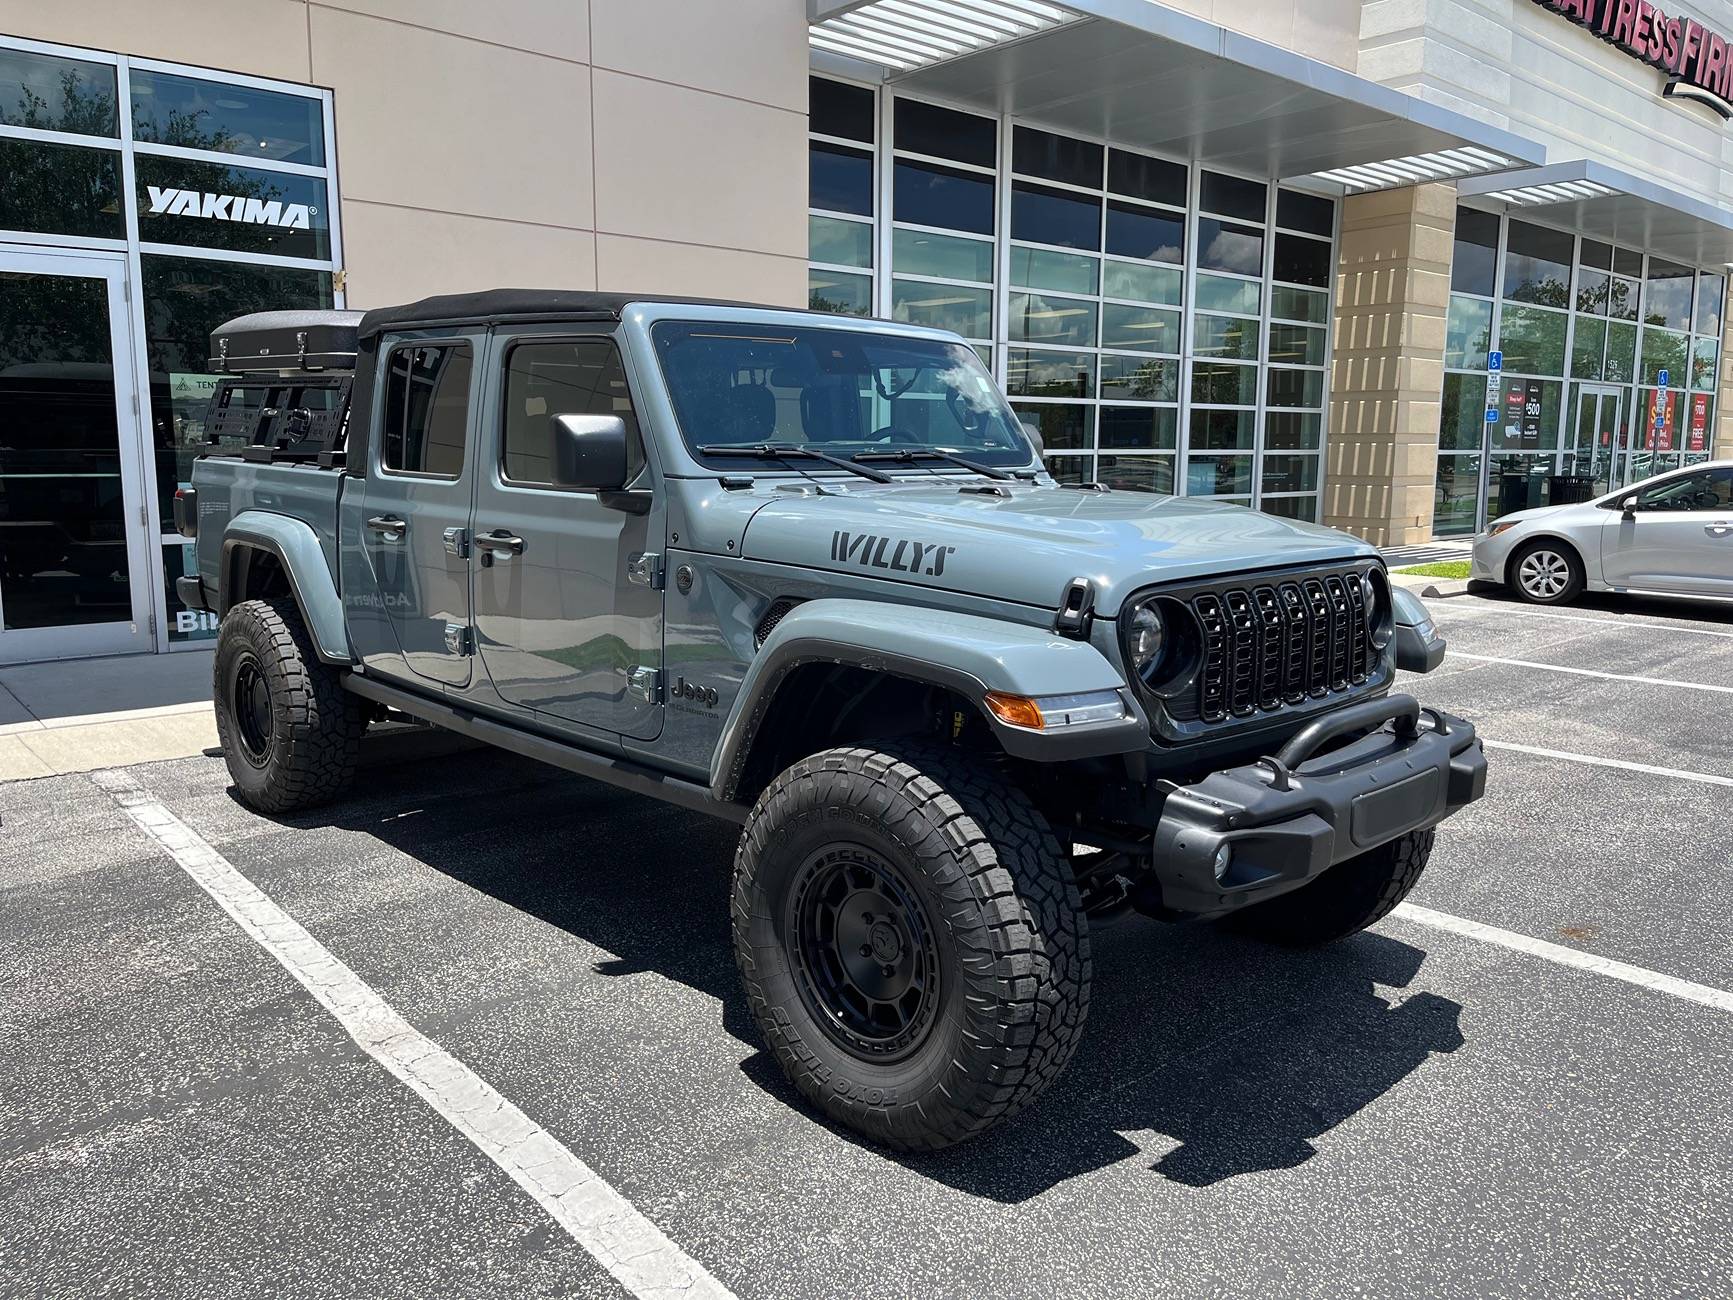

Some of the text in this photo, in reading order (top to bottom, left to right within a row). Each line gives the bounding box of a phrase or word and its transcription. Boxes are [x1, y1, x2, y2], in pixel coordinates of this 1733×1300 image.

[1525, 402, 1540, 416] $500
[830, 530, 956, 577] WILLYS
[671, 675, 719, 709] Jeep
[770, 1006, 898, 1107] TOYO TIRES
